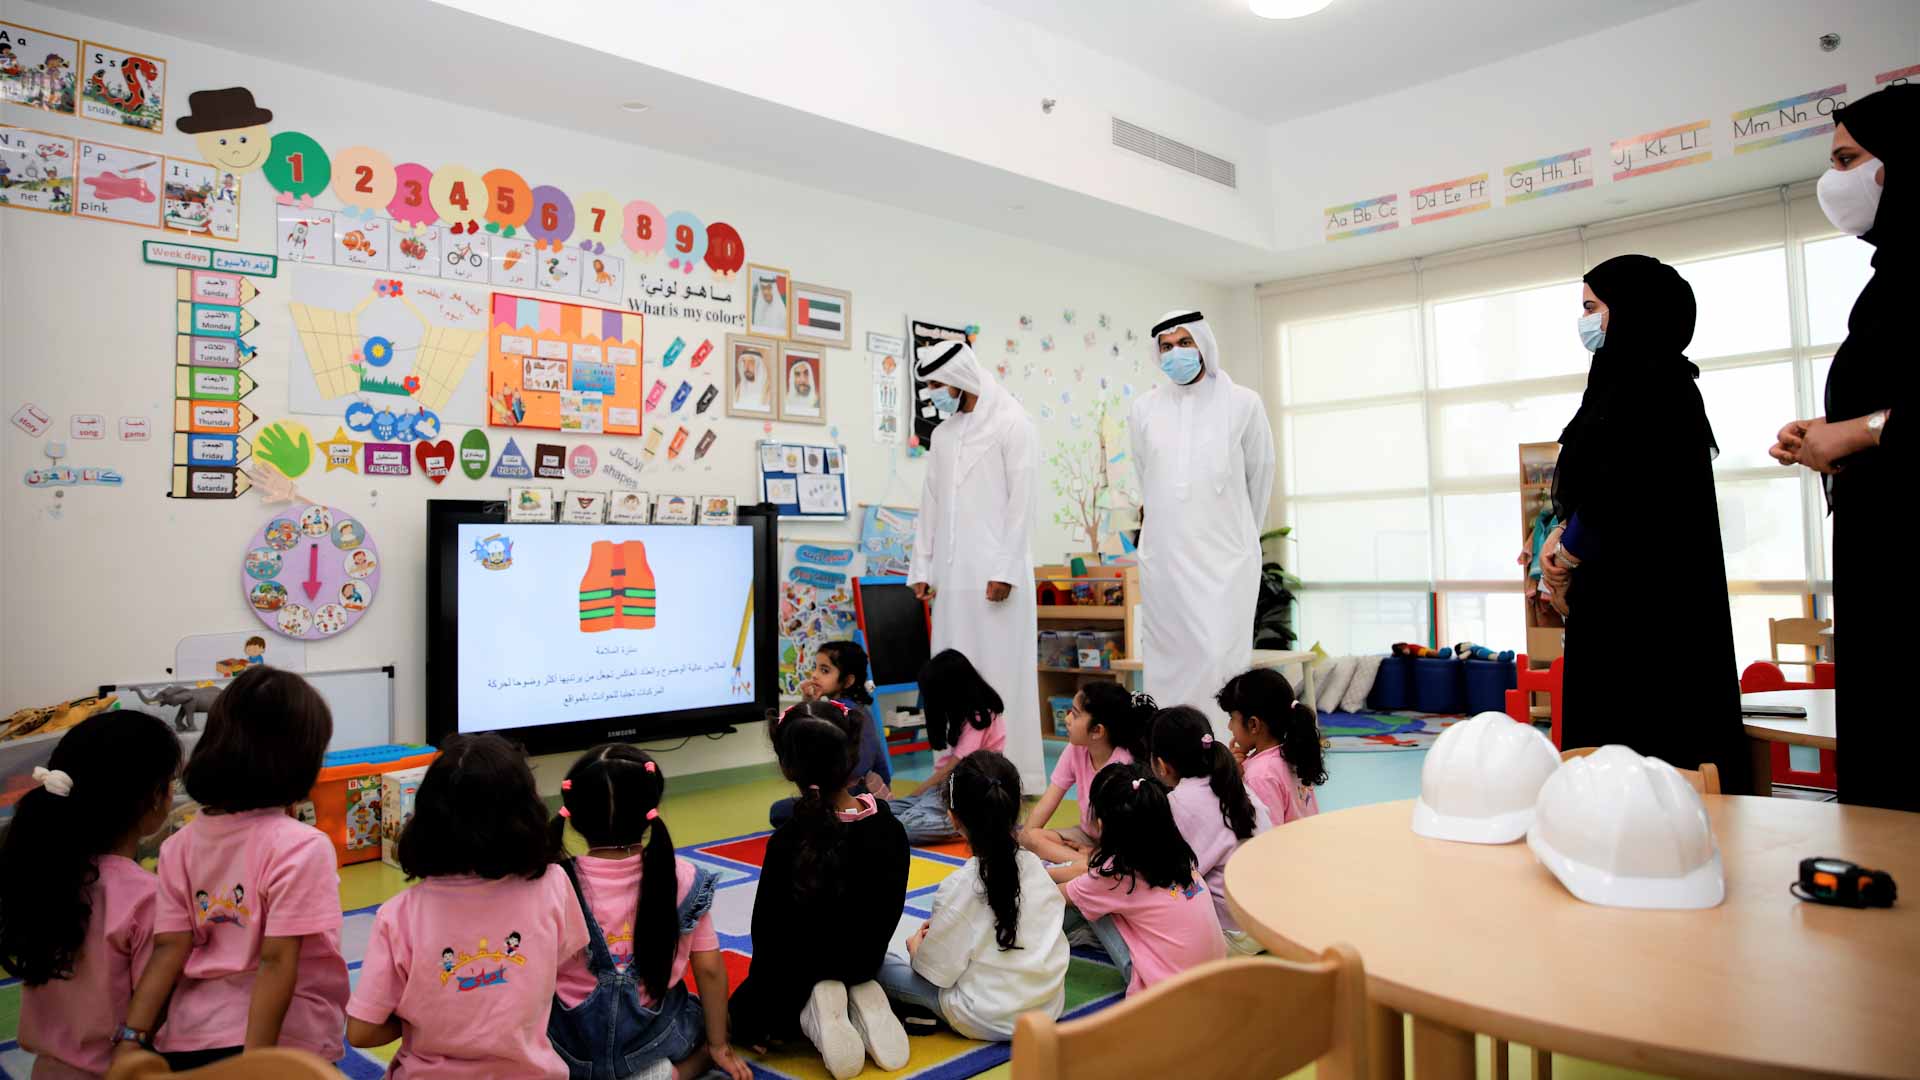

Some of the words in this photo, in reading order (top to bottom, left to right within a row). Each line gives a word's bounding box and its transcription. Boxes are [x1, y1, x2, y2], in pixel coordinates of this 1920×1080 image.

[18, 36, 26, 46] a
[94, 53, 103, 64] S
[109, 59, 116, 68] s
[87, 104, 117, 117] snake
[1734, 116, 1770, 139] Mm
[1779, 106, 1807, 128] Nn
[0, 134, 9, 146] N
[16, 138, 25, 148] n
[83, 146, 92, 158] P
[97, 153, 106, 164] p
[1614, 149, 1632, 171] Jj
[1644, 138, 1668, 159] Kk
[287, 153, 304, 183] 1
[354, 165, 374, 194] 2
[1509, 172, 1532, 193] Gg
[1542, 164, 1563, 183] Hh
[20, 192, 38, 202] net
[404, 180, 422, 207] 3
[449, 181, 470, 211] 4
[496, 186, 515, 215] 5
[1416, 193, 1436, 211] Dd
[1444, 188, 1461, 205] Ee
[1470, 180, 1486, 199] Ff
[81, 202, 108, 214] pink
[1328, 213, 1348, 230] Aa
[1353, 208, 1372, 224] Bb
[1378, 202, 1398, 218] Cc
[540, 202, 559, 232] 6
[591, 208, 606, 232] 7
[216, 222, 230, 233] ink
[636, 214, 652, 240] 8
[675, 224, 694, 254] 9
[714, 237, 736, 257] 10
[152, 247, 181, 259] Week
[184, 250, 208, 263] days
[202, 289, 228, 299] Sunday
[628, 298, 665, 317] What
[669, 302, 678, 317] is
[684, 307, 702, 322] my
[706, 310, 746, 327] color?
[202, 322, 231, 331] Monday
[200, 353, 229, 364] Tuesday
[199, 418, 231, 427] Thursday
[202, 452, 224, 460] Friday
[368, 464, 408, 474] rectangle
[428, 468, 448, 476] heart
[497, 466, 528, 475] triangle
[603, 464, 638, 488] shapes
[198, 484, 228, 493] Saturday
[608, 728, 637, 738] SAMSUNG
